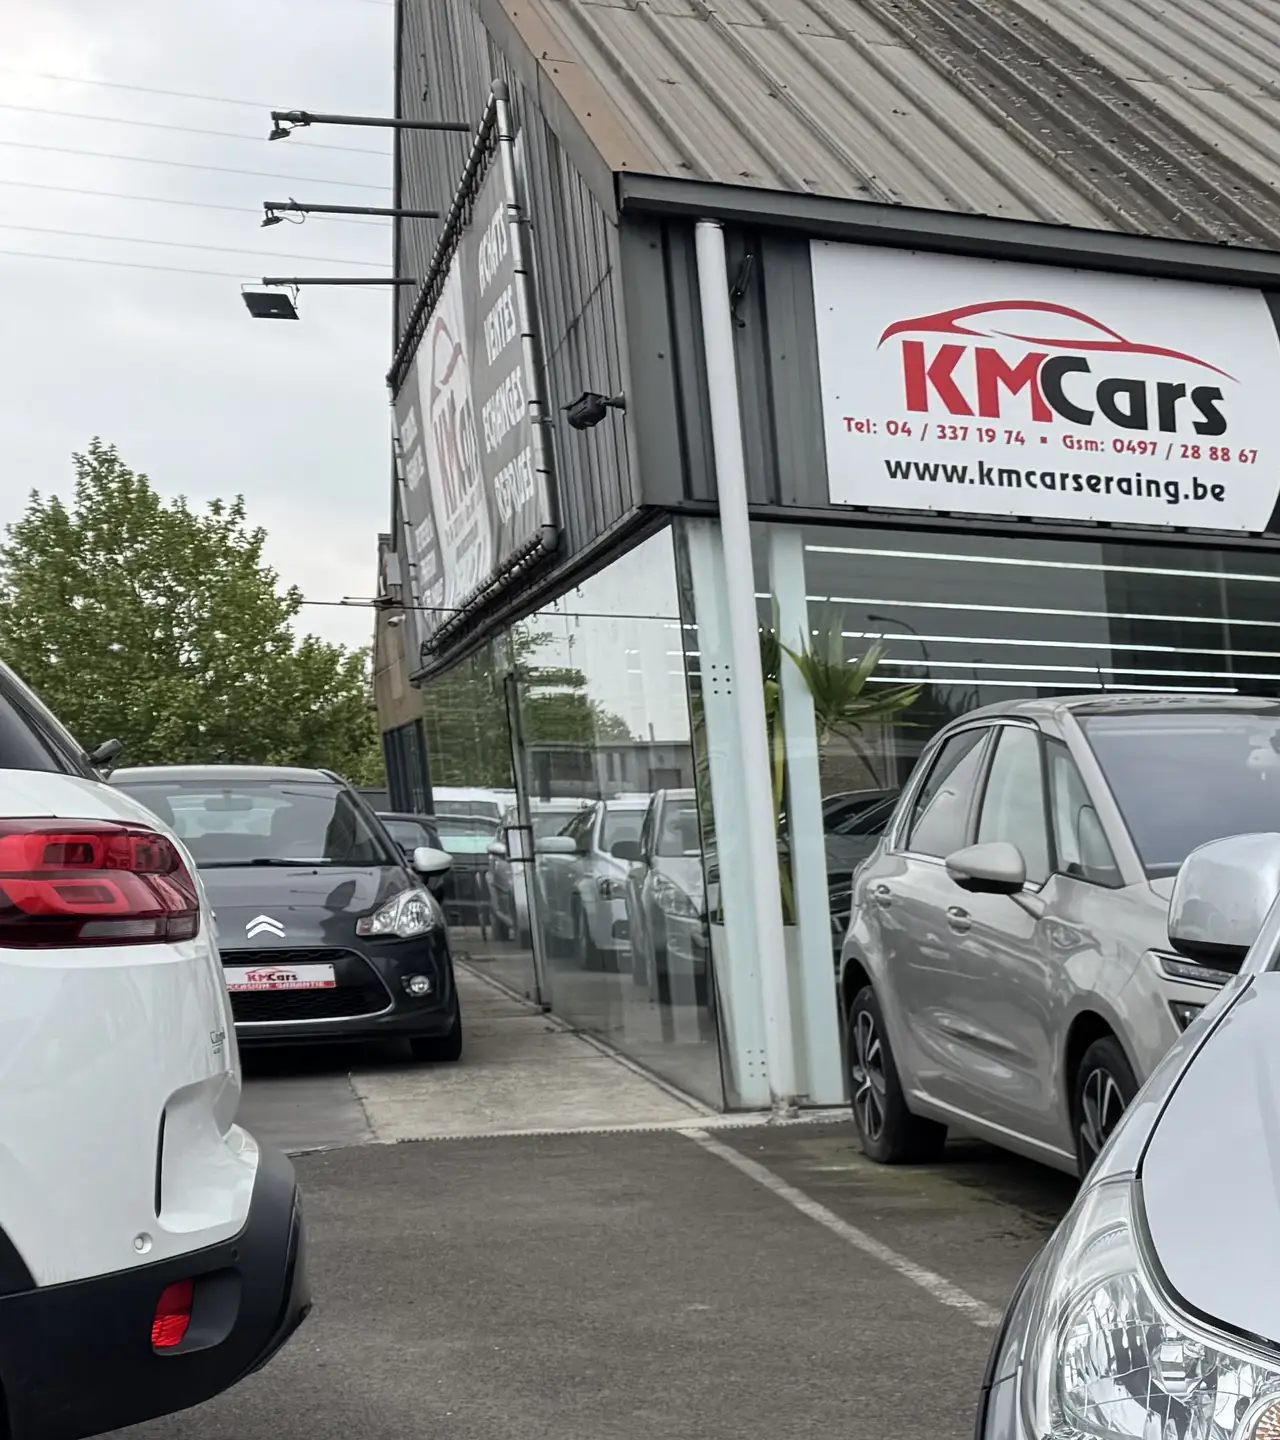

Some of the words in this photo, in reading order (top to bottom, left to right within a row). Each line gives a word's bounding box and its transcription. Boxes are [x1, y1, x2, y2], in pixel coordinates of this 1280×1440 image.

[902, 340, 1227, 437] KMCars
[843, 416, 878, 434] Tel:
[885, 420, 912, 437] 04
[936, 424, 969, 442] 337
[976, 427, 997, 443] 19
[1004, 430, 1026, 446] 74
[1062, 434, 1105, 452] Gsm:
[1112, 438, 1158, 456] 0497
[1180, 444, 1202, 459] 28
[1209, 446, 1231, 462] 88
[1238, 448, 1258, 464] 67
[884, 459, 1226, 505] www.kmcarseraing.be
